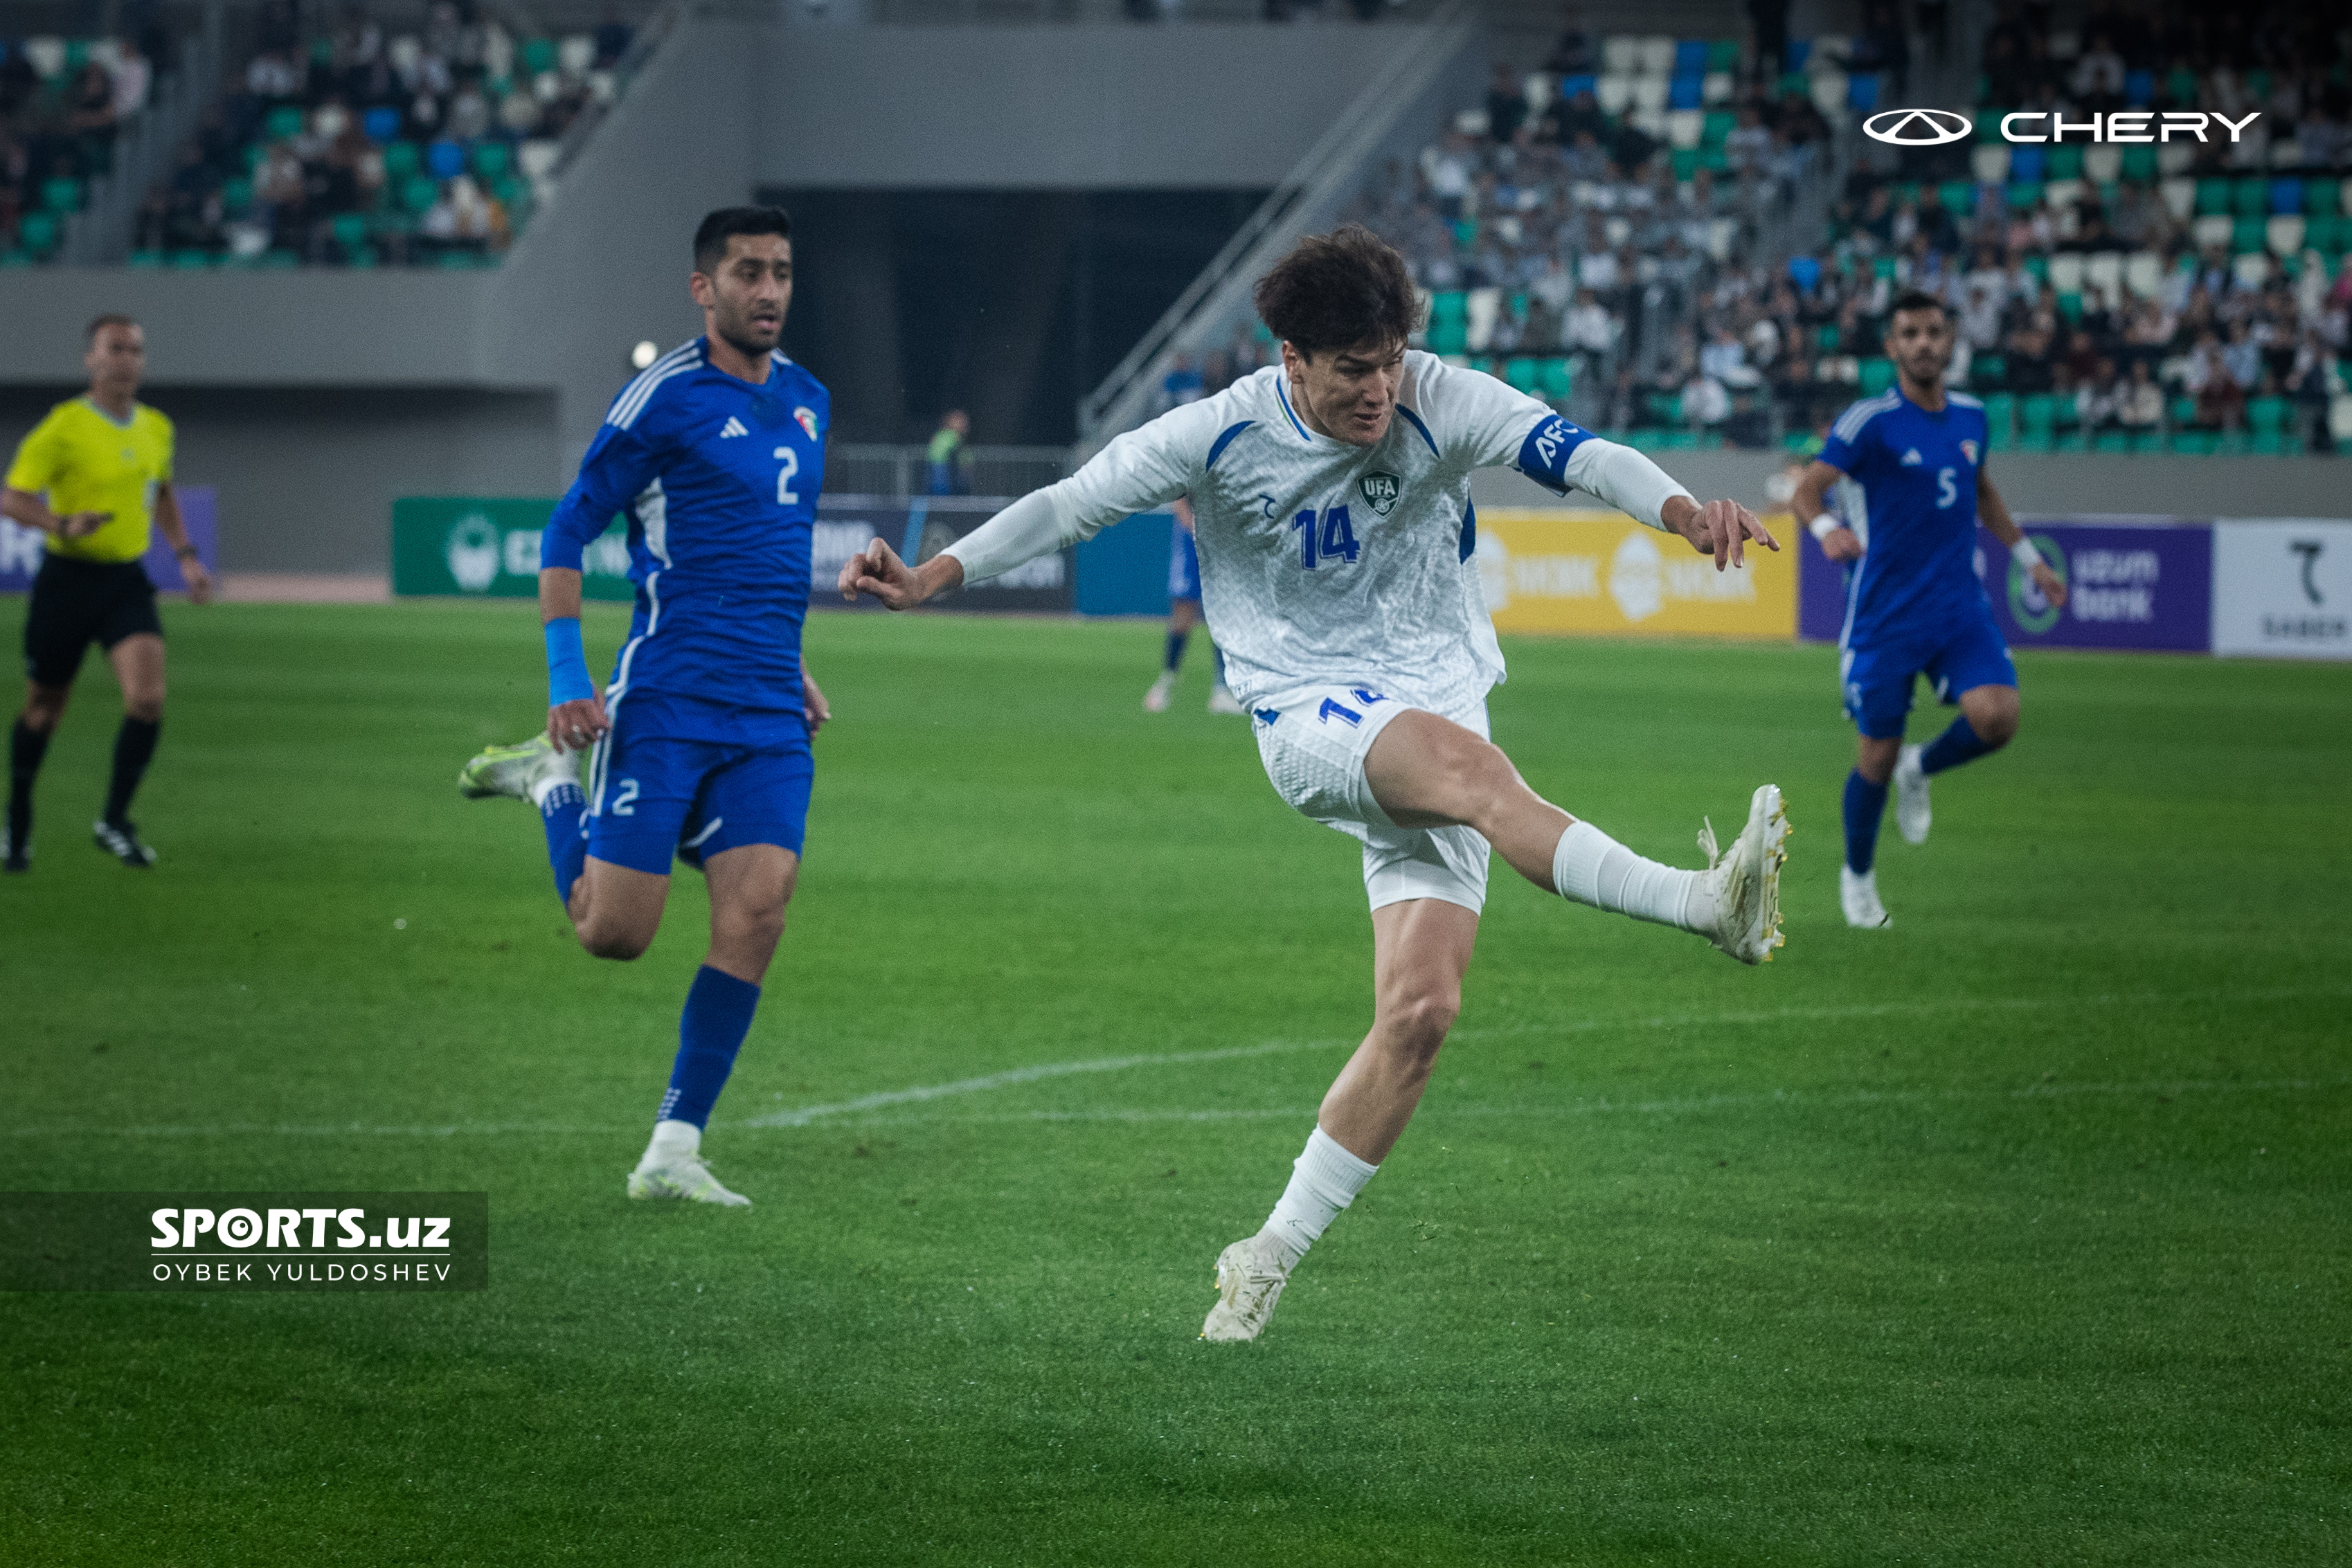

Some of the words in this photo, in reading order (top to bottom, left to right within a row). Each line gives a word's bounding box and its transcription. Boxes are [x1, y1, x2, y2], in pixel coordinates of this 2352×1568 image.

[1535, 419, 1579, 469] AFC
[773, 447, 798, 505] 2
[1364, 479, 1396, 496] UFA
[1937, 467, 1957, 507] 5
[1292, 504, 1362, 570] 14
[612, 779, 640, 816] 2
